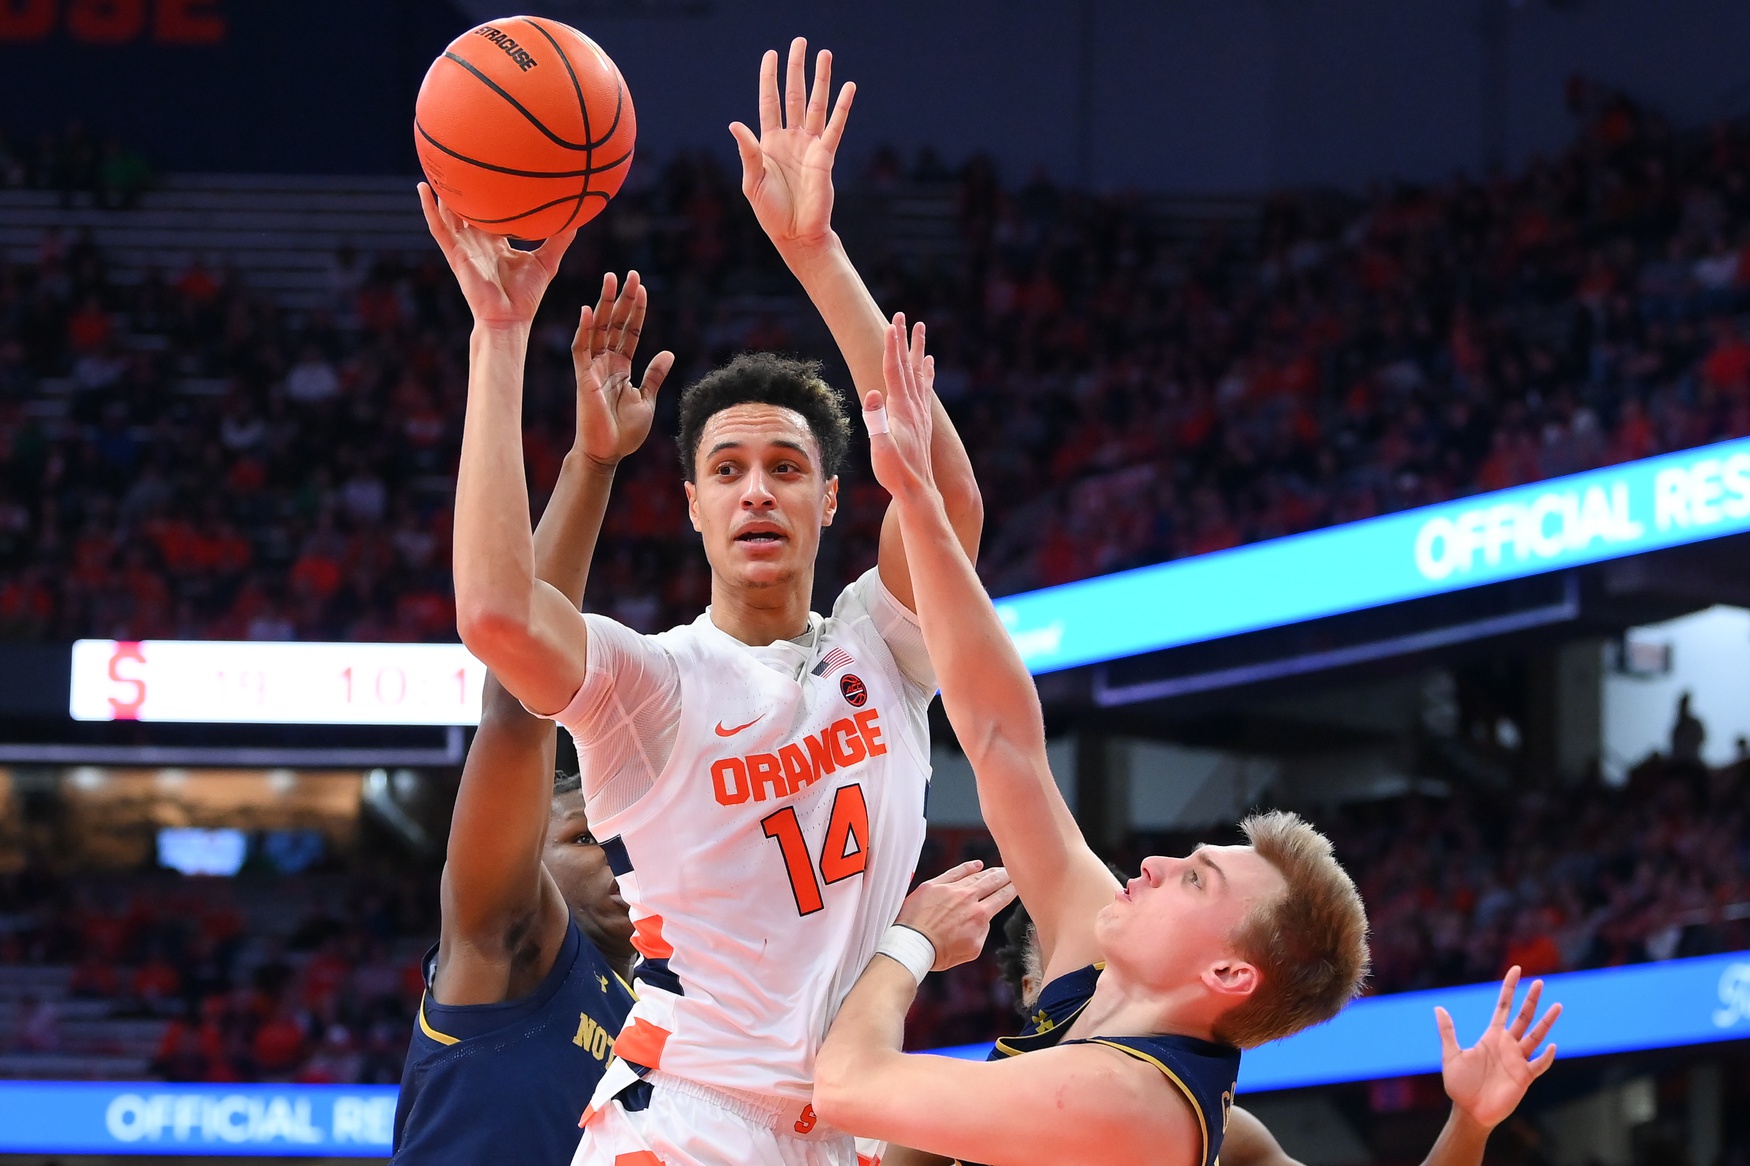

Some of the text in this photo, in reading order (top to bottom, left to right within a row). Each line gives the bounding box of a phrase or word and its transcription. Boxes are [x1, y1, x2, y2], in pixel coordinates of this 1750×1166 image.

[1414, 453, 1750, 580] OFFICIAL RES
[710, 708, 887, 806] ORANGE
[760, 783, 870, 917] 14
[105, 1093, 325, 1144] OFFICIAL
